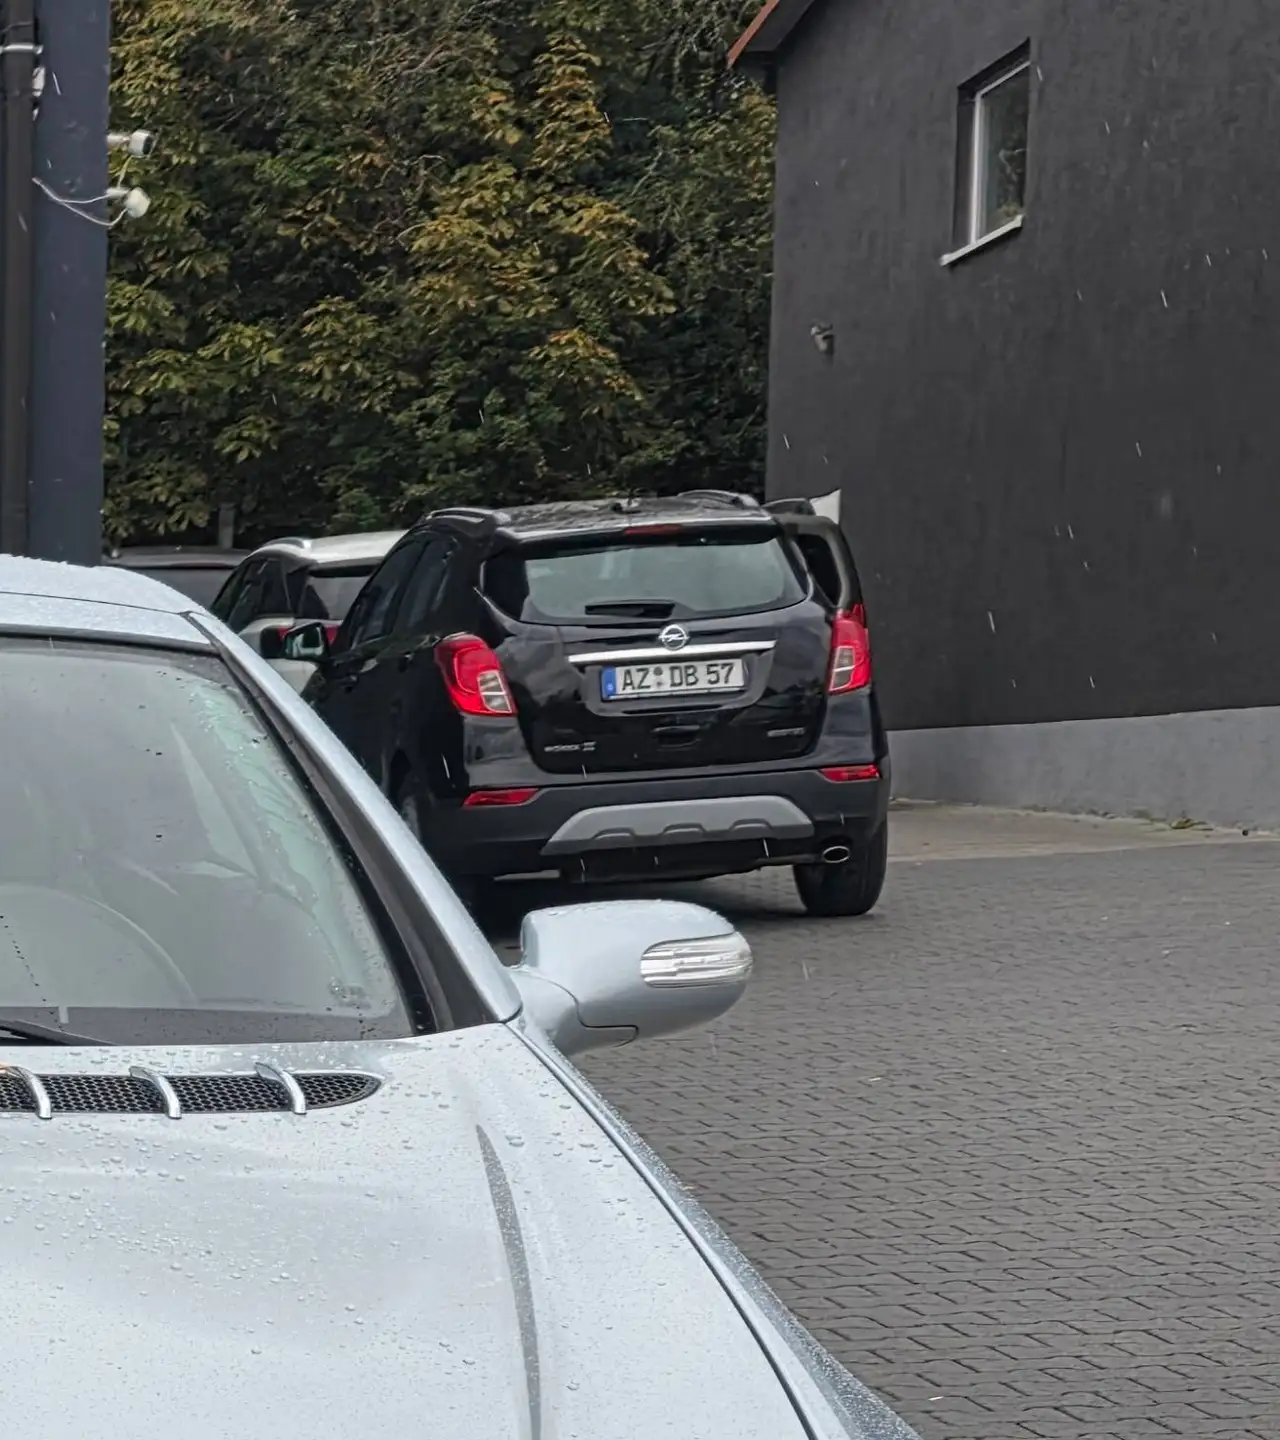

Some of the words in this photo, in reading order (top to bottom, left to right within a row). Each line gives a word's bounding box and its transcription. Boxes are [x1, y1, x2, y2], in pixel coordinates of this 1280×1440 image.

[622, 668, 651, 690] AZ
[670, 665, 699, 687] DB
[706, 662, 734, 684] 57
